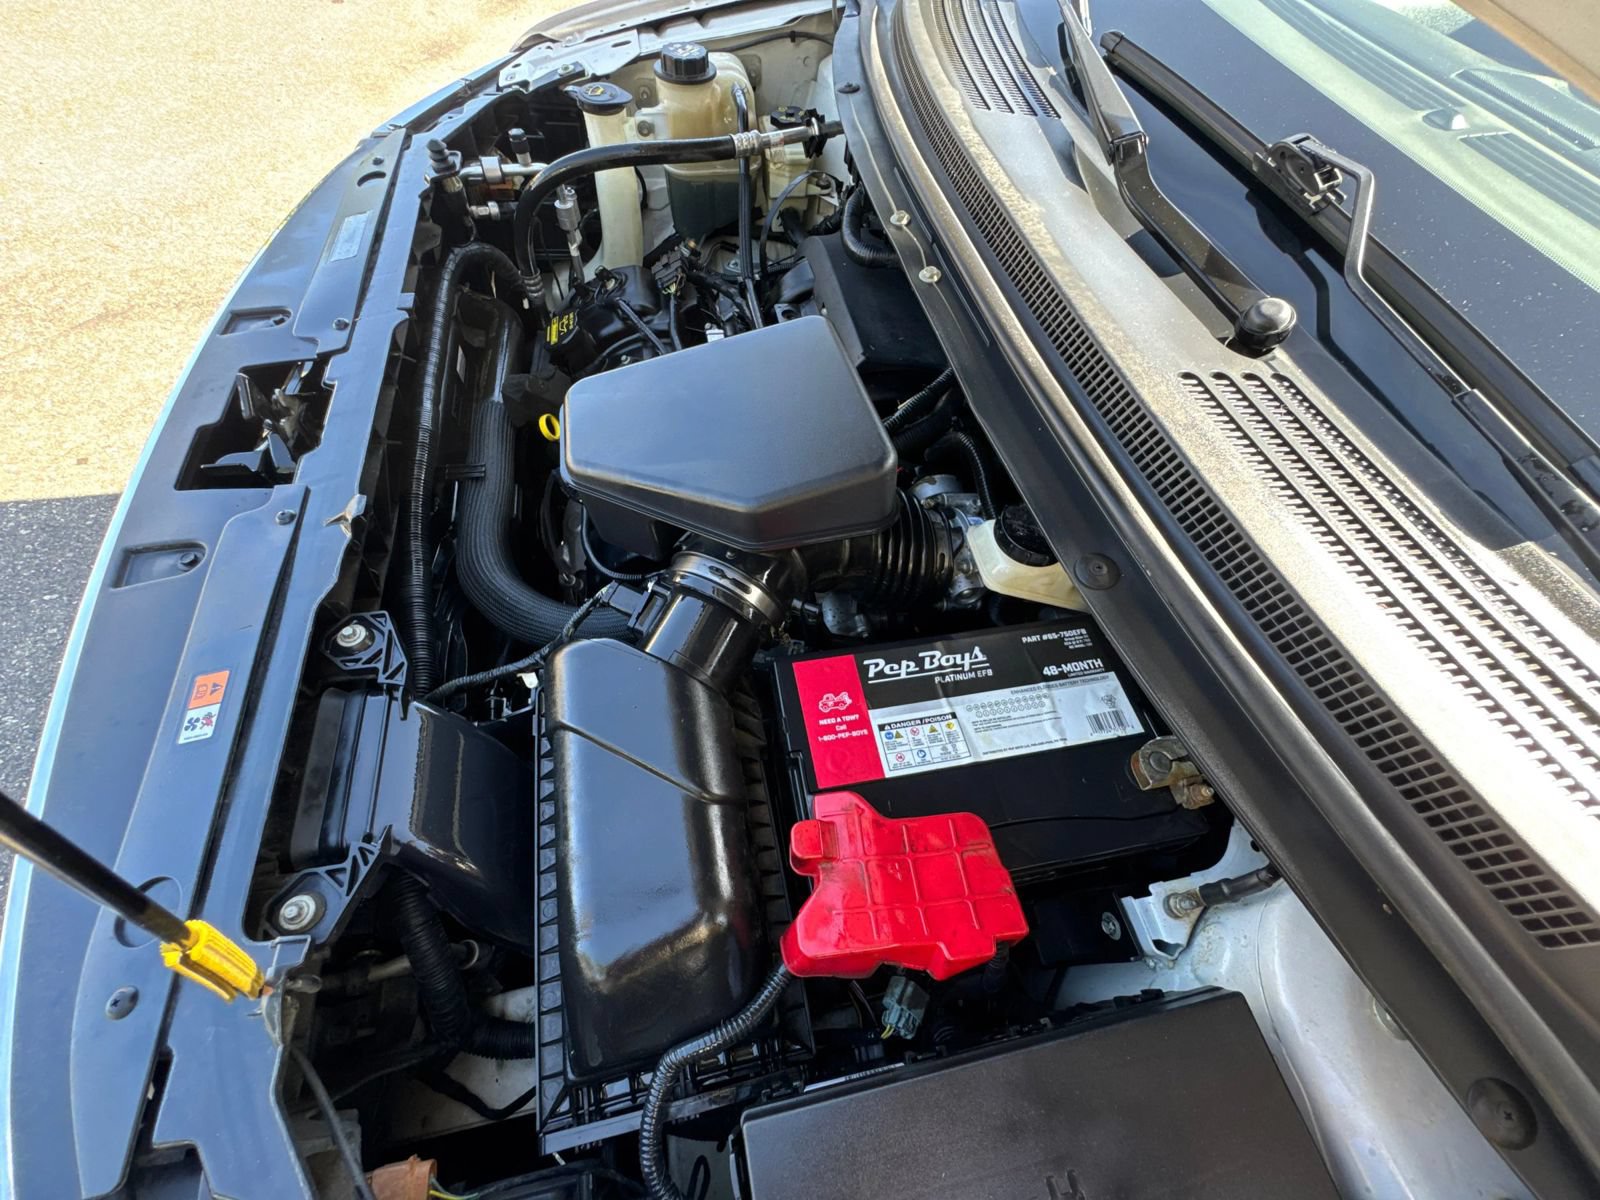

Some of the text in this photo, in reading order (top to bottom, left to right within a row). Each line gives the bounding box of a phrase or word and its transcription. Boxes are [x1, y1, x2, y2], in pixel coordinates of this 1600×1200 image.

[1021, 634, 1041, 644] PART
[863, 646, 988, 678] Pep Boys
[1042, 658, 1104, 677] 48-MONTH
[934, 668, 993, 684] PLATINUM EFB
[818, 717, 836, 725] NEED
[842, 714, 859, 722] TOW?
[890, 719, 921, 729] DANGER
[817, 729, 868, 742] 1-800-PEP-BOYS
